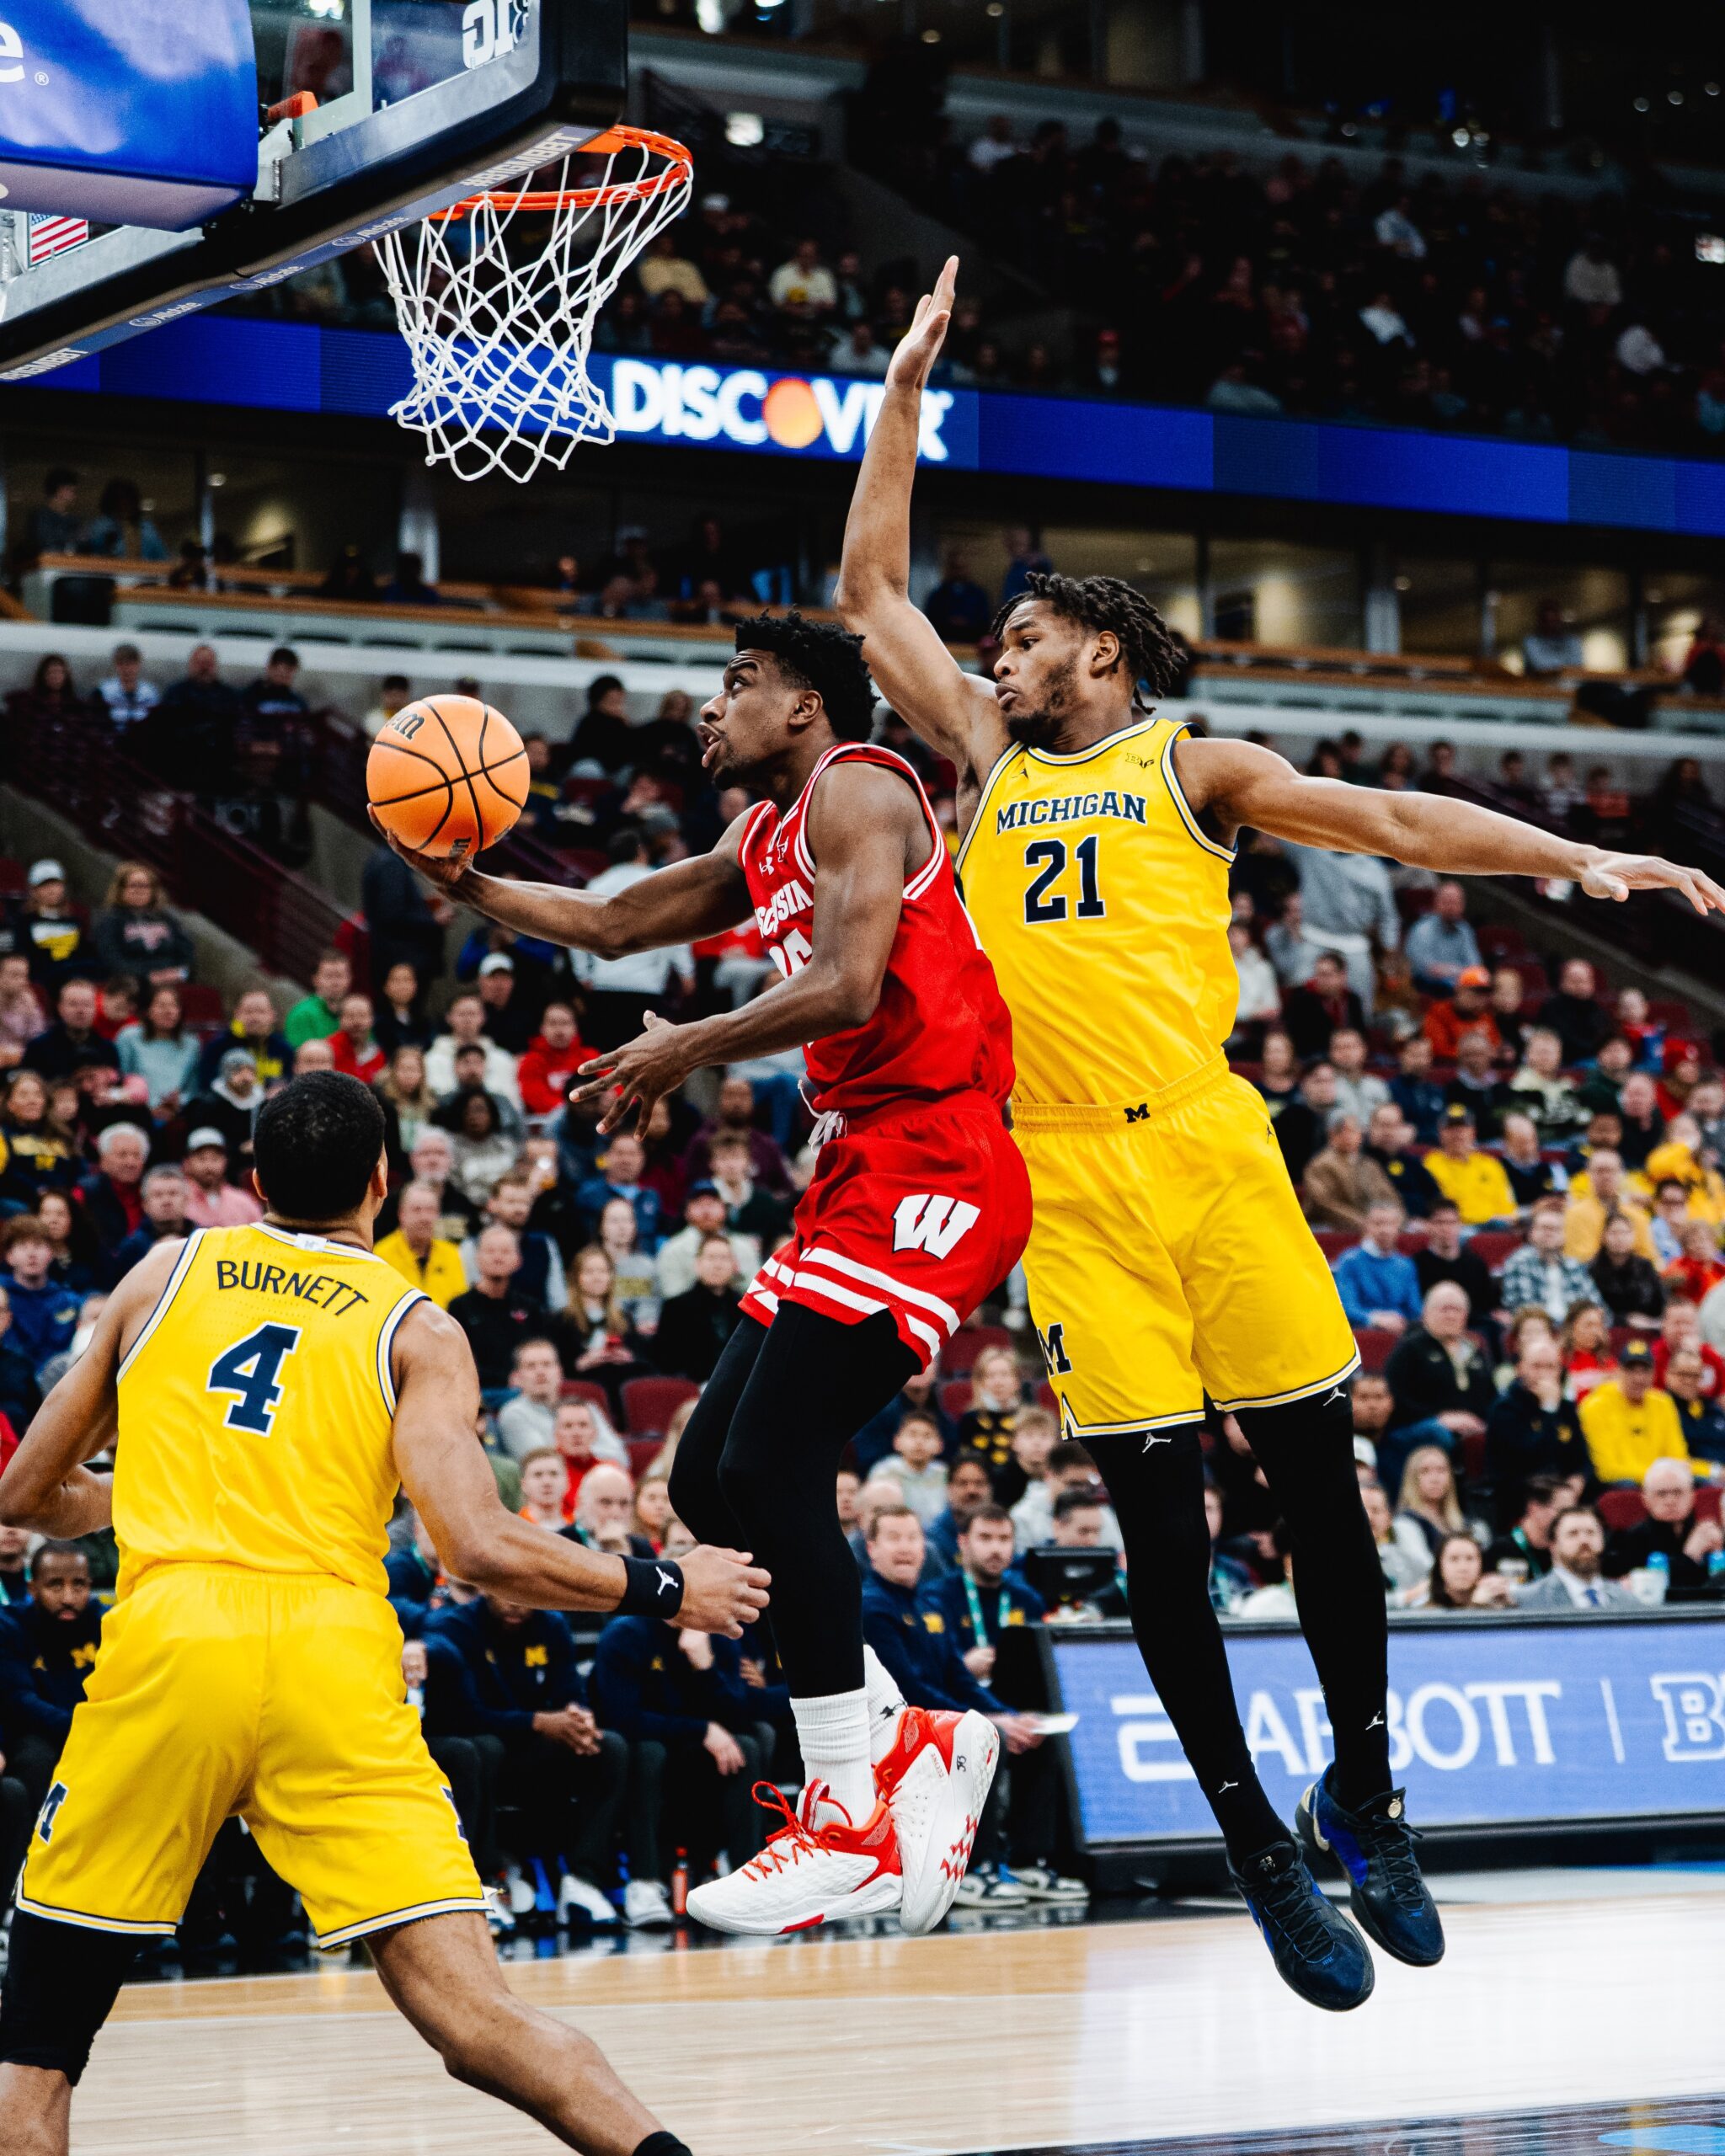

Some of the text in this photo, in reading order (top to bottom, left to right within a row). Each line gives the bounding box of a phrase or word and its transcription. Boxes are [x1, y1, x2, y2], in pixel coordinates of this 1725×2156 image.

[357, 216, 409, 238] Allstate
[254, 264, 305, 286] Allstate
[153, 302, 202, 322] Allstate
[996, 791, 1147, 836] MICHIGAN
[1024, 834, 1107, 925] 21
[1124, 1102, 1151, 1124] M
[891, 1193, 982, 1262] W
[216, 1260, 369, 1316] BURNETT
[206, 1321, 303, 1438] 4
